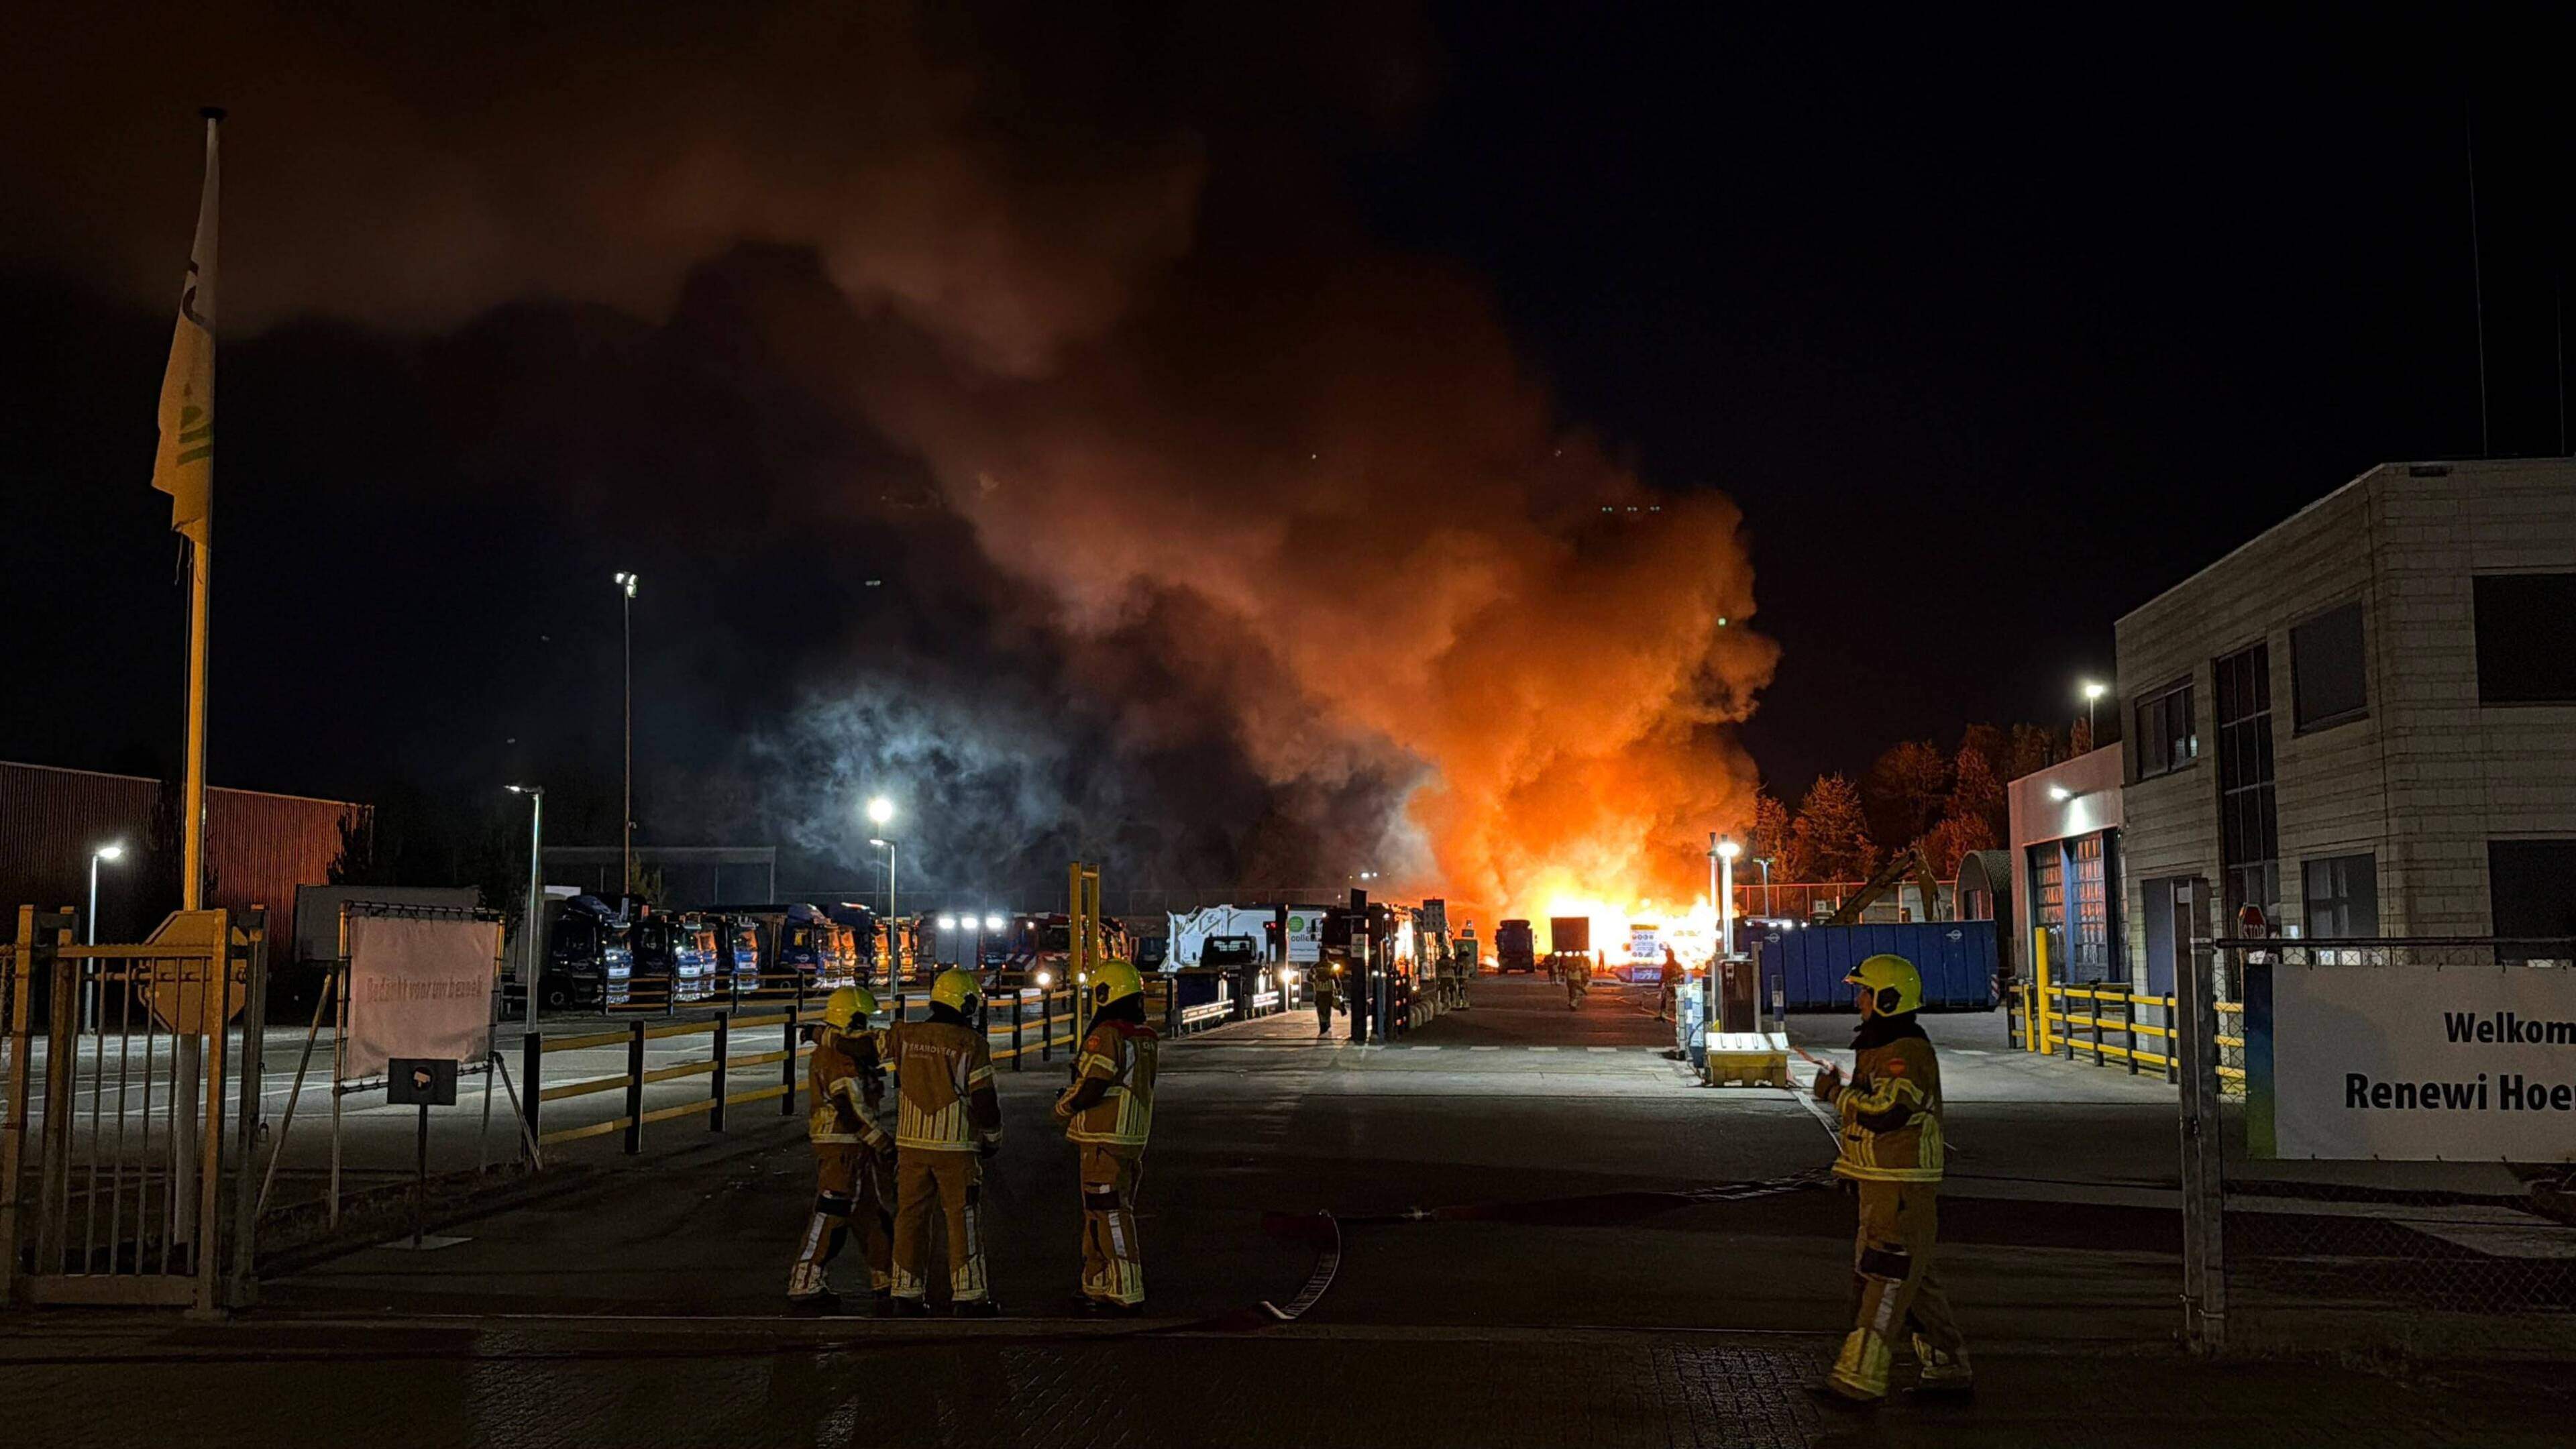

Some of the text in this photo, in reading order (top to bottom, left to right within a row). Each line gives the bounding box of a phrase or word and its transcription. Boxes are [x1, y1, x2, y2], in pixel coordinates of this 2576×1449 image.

[2243, 924, 2265, 939] STOP
[2445, 1012, 2576, 1044] Welkom
[2346, 1073, 2576, 1110] Renewi Hoe
